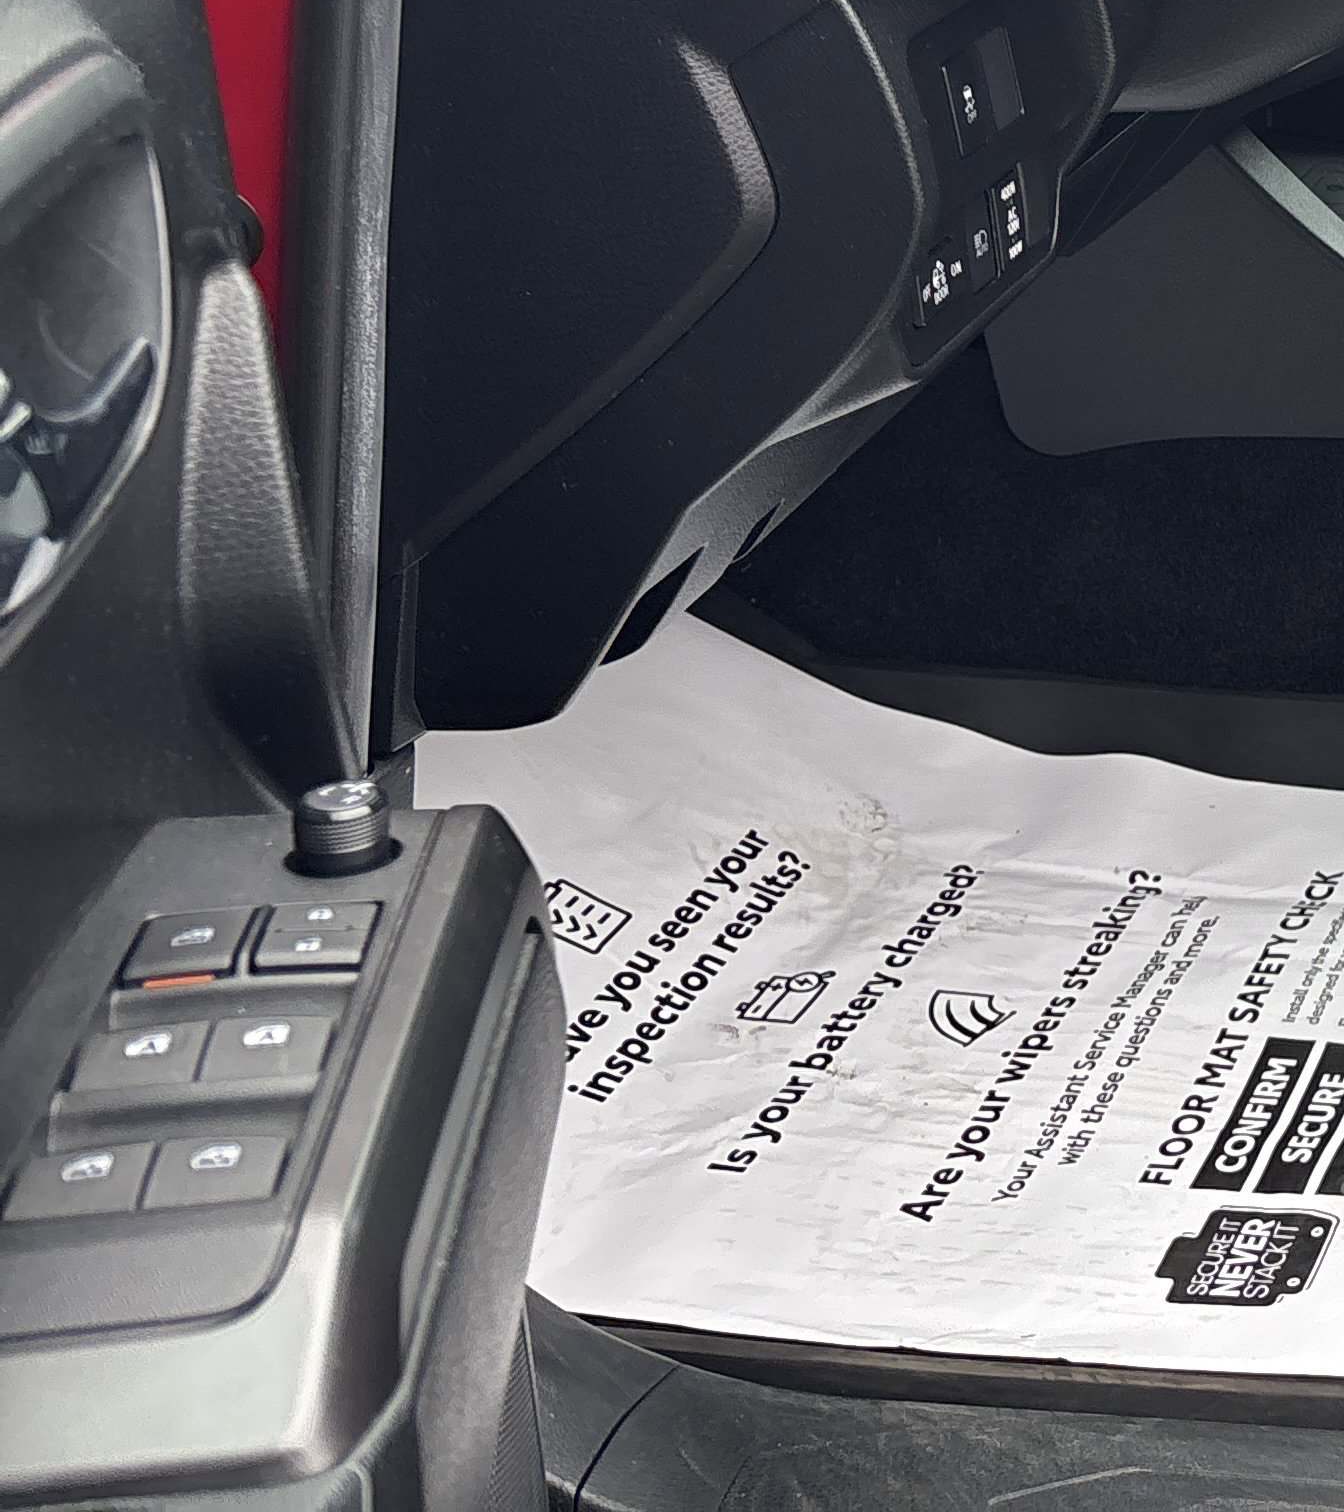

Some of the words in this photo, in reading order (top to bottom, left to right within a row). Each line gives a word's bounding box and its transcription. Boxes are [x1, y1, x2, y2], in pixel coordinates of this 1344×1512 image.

[950, 260, 962, 277] ON
[565, 1009, 609, 1063] ave
[594, 950, 661, 1013] you
[648, 888, 719, 952] seen
[704, 829, 769, 893] your
[567, 953, 727, 1102] inspection
[712, 850, 811, 953] results?
[707, 1148, 758, 1173] Is
[741, 1075, 814, 1143] your
[788, 971, 902, 1070] battery
[881, 864, 985, 968] charged?
[1282, 988, 1308, 1023] Install
[1301, 966, 1322, 987] only
[1312, 947, 1330, 966] the
[1307, 973, 1339, 1025] designed
[900, 1166, 963, 1222] Are
[945, 1090, 1011, 1162] your
[995, 995, 1076, 1085] wipers
[1062, 870, 1163, 990] streaking?
[991, 1155, 1037, 1202] Your
[1024, 1074, 1090, 1160] Assistant
[1074, 1012, 1126, 1071] Service
[1110, 949, 1169, 1009] Manager
[1161, 919, 1188, 947] can
[1057, 1128, 1096, 1166] with
[1080, 1072, 1126, 1124] these
[1116, 988, 1173, 1068] questions
[1163, 960, 1192, 986] and
[1183, 915, 1220, 958] more.
[1138, 1094, 1219, 1185] FLOOR
[1194, 1028, 1250, 1088] MAT
[1228, 934, 1298, 1024] SAFETY
[1214, 1057, 1298, 1174] CONFIRM
[1186, 1233, 1235, 1296] SECURE
[1219, 1217, 1241, 1231] IT
[1208, 1218, 1276, 1298] NEVER
[1242, 1241, 1294, 1299] STACK
[1272, 1221, 1300, 1239] IT
